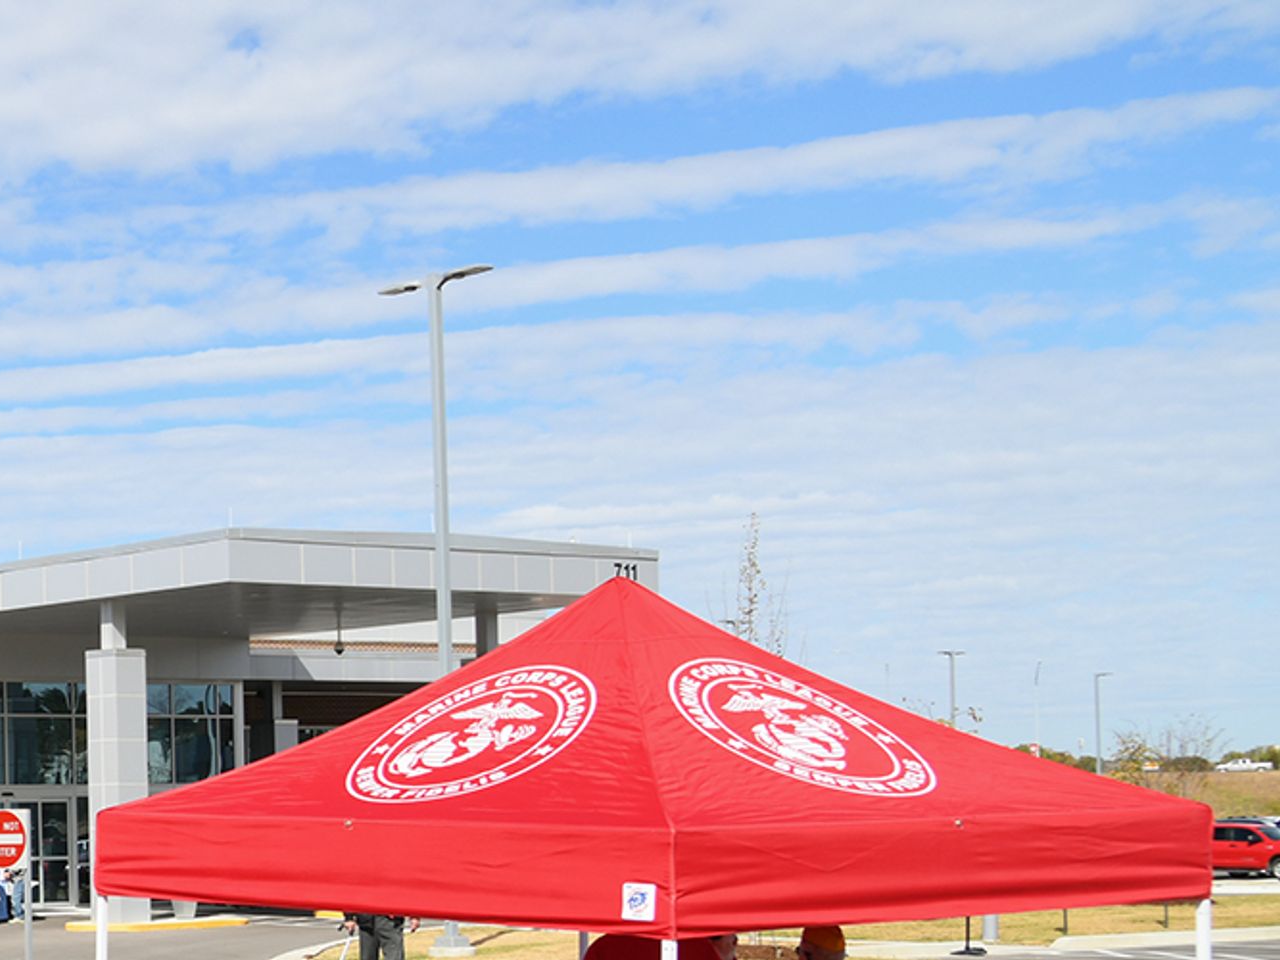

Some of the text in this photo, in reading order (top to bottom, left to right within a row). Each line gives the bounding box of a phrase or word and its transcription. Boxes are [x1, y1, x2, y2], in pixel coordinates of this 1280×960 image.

[613, 562, 638, 581] 711
[394, 670, 586, 738] MARINE CORPS LEAGUE
[679, 663, 870, 730] MARINE CORPS LEAGUE
[355, 765, 508, 799] SEMPER FIDELIS
[772, 758, 890, 792] SEMPER
[3, 821, 19, 832] NOT
